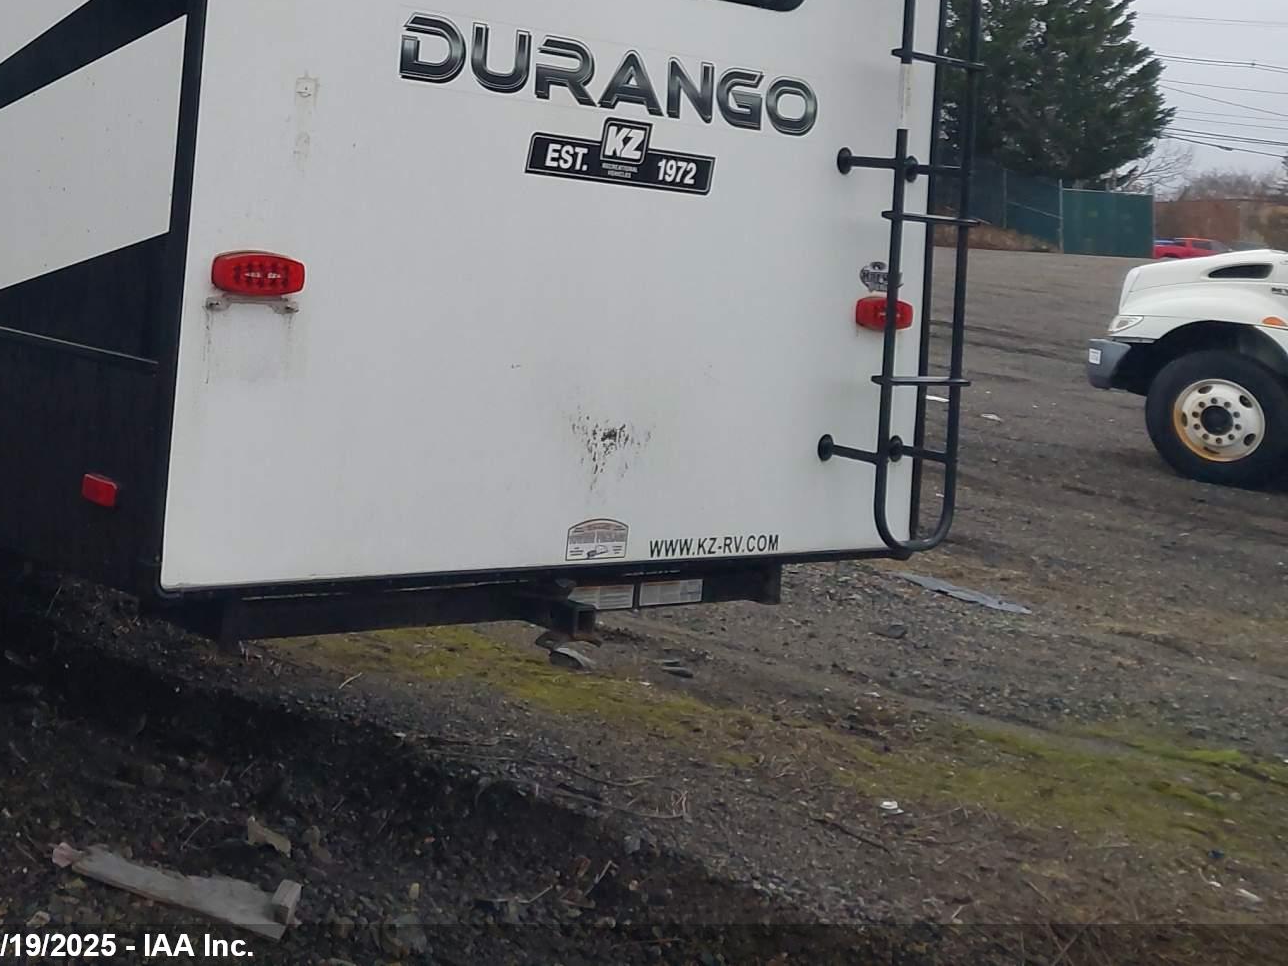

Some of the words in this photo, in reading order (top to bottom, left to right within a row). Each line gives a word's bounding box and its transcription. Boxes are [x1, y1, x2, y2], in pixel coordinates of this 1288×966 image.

[400, 12, 817, 135] DURANGO
[604, 125, 646, 160] KZ
[544, 143, 589, 172] EST.
[657, 158, 698, 185] 1972
[649, 534, 780, 559] WWW.KZ-RV.COM
